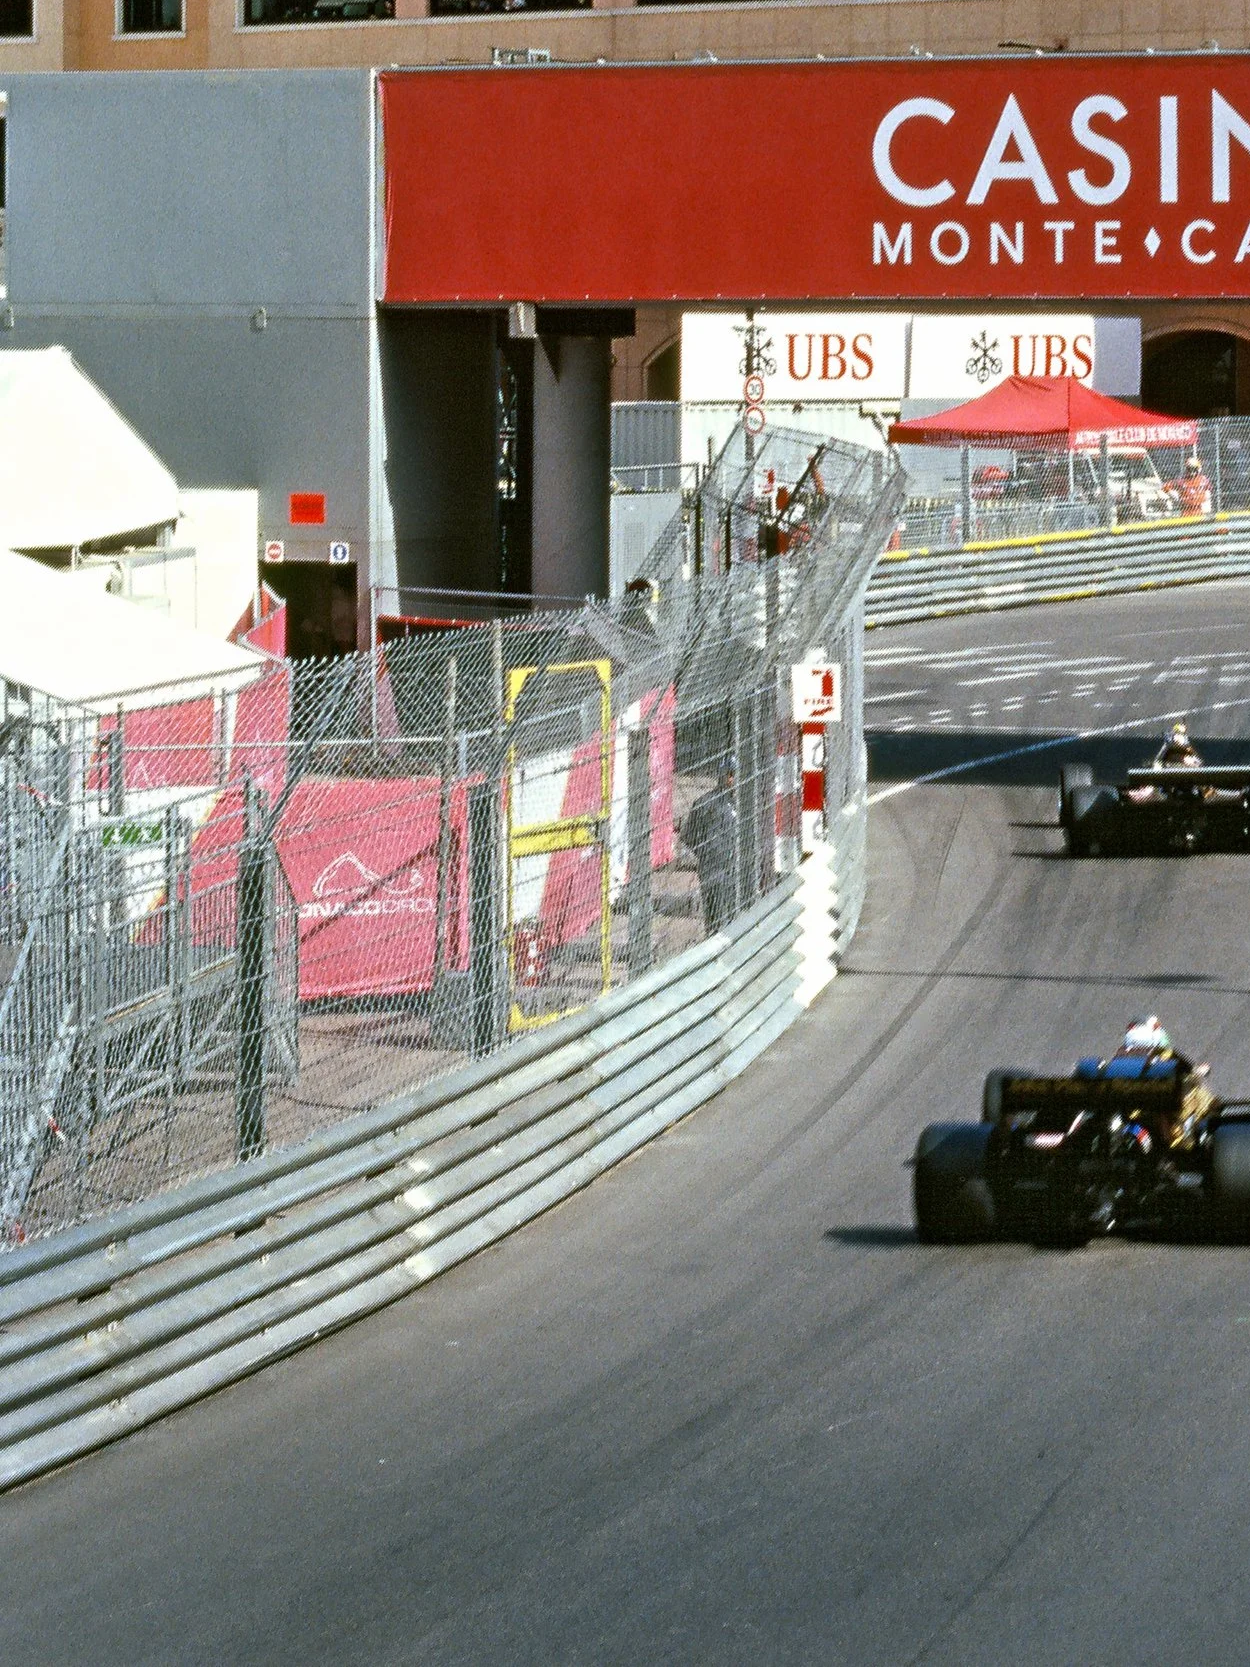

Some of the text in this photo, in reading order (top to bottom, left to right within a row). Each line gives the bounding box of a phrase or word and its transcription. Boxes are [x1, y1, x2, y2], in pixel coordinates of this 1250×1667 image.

[871, 219, 1123, 267] MONTE
[785, 333, 874, 381] UBS
[1010, 334, 1093, 380] UBS
